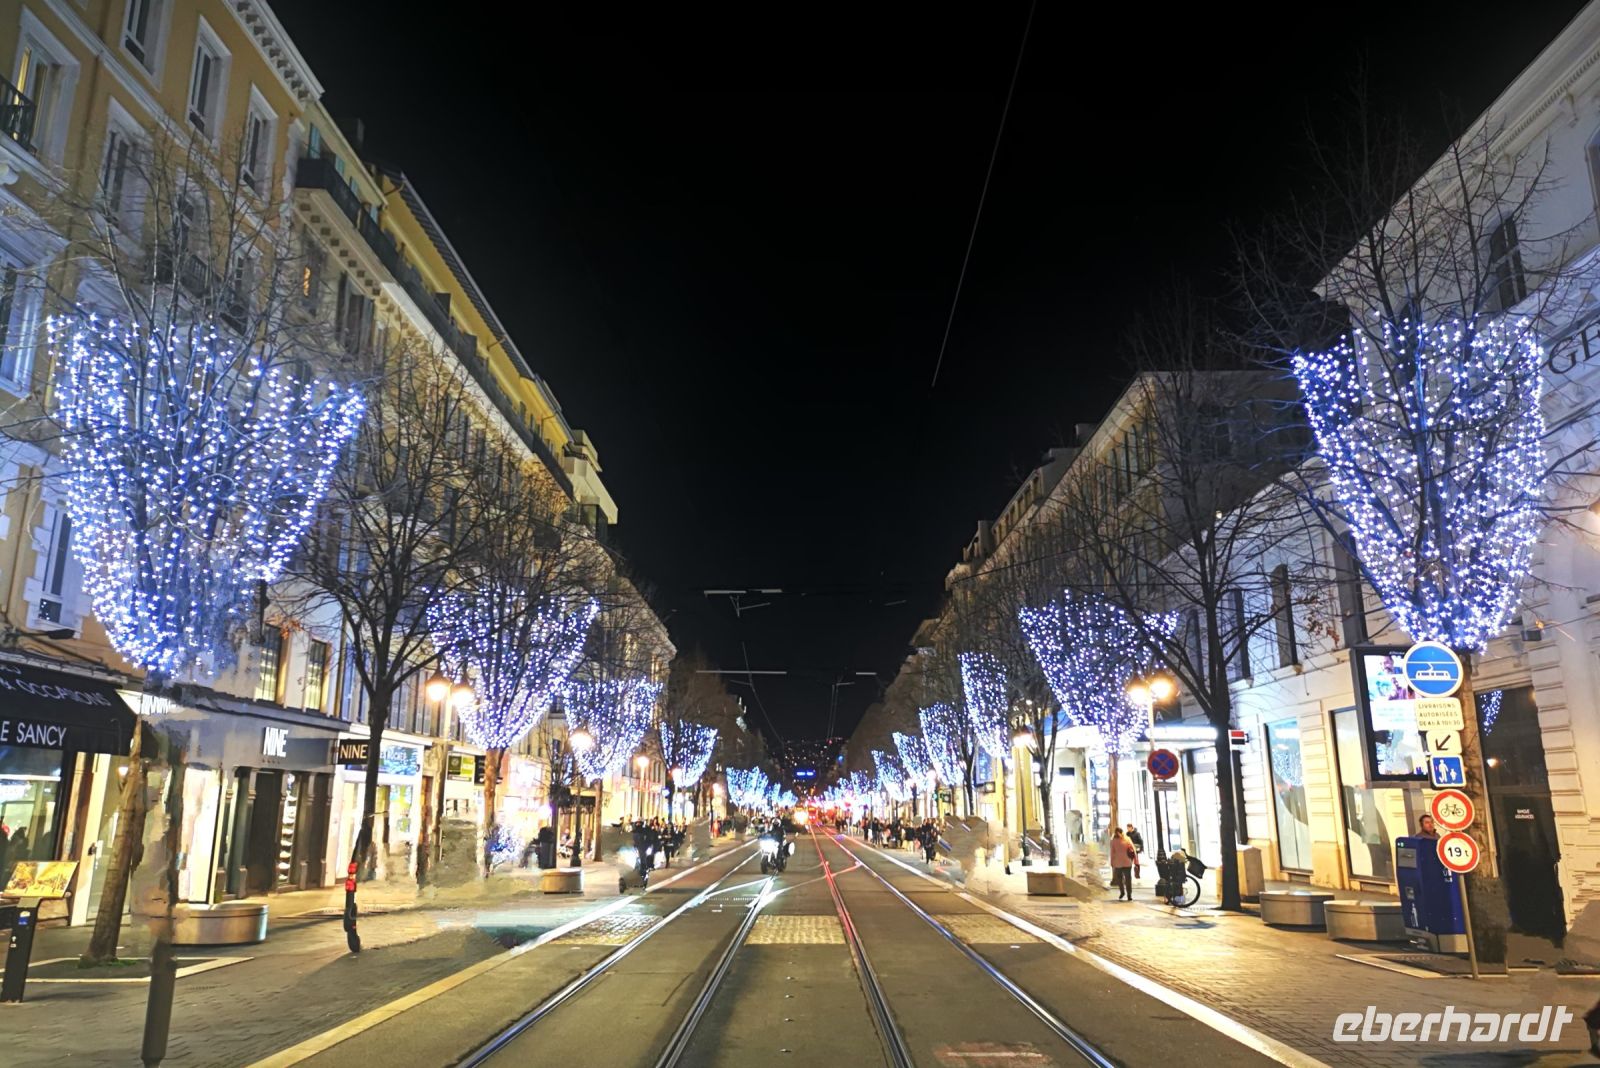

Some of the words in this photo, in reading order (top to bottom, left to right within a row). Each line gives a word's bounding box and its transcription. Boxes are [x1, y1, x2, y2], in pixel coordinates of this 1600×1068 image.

[16, 722, 67, 746] SANCY
[263, 726, 289, 757] NINE
[340, 744, 368, 759] NINE
[1447, 846, 1462, 857] 19
[1464, 849, 1469, 857] t
